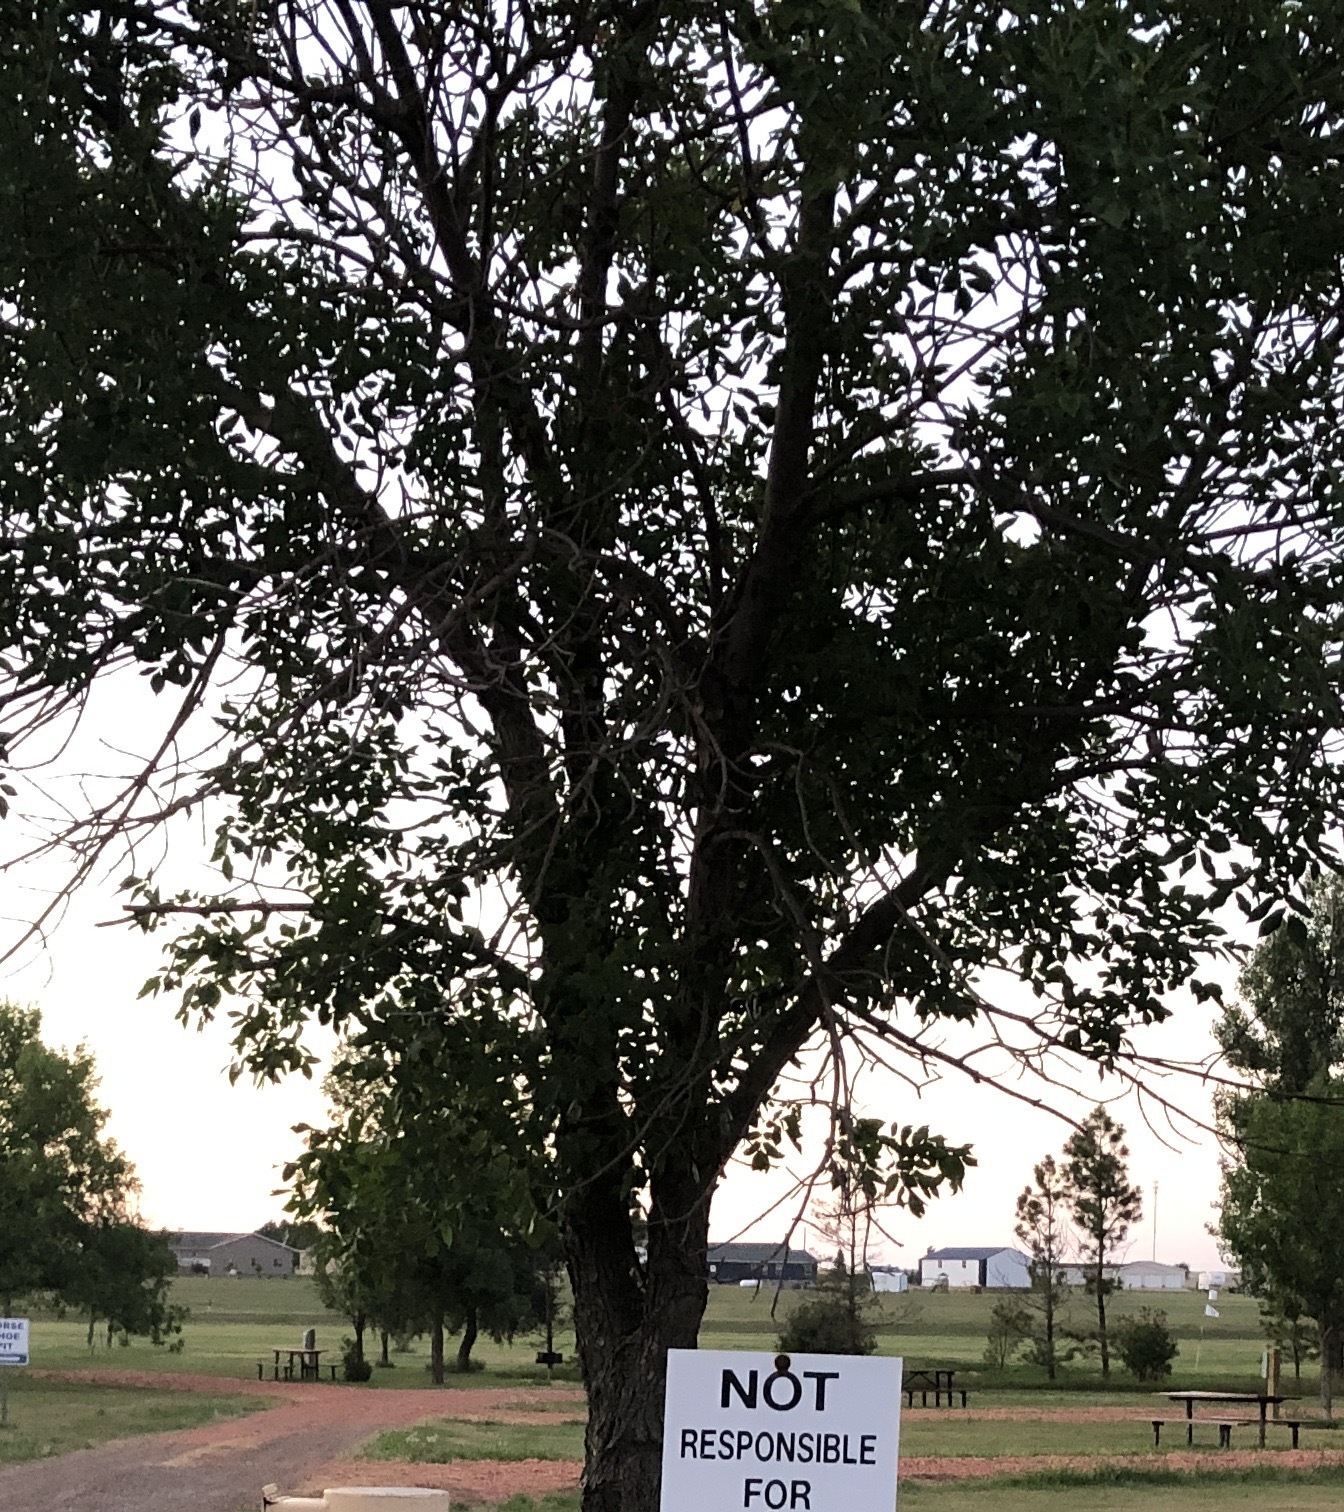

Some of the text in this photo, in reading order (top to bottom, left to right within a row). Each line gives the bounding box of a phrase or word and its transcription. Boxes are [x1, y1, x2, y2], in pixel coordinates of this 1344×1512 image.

[720, 1368, 840, 1411] NOT
[680, 1428, 878, 1465] RESPONSIBLE
[743, 1478, 811, 1511] FOR
